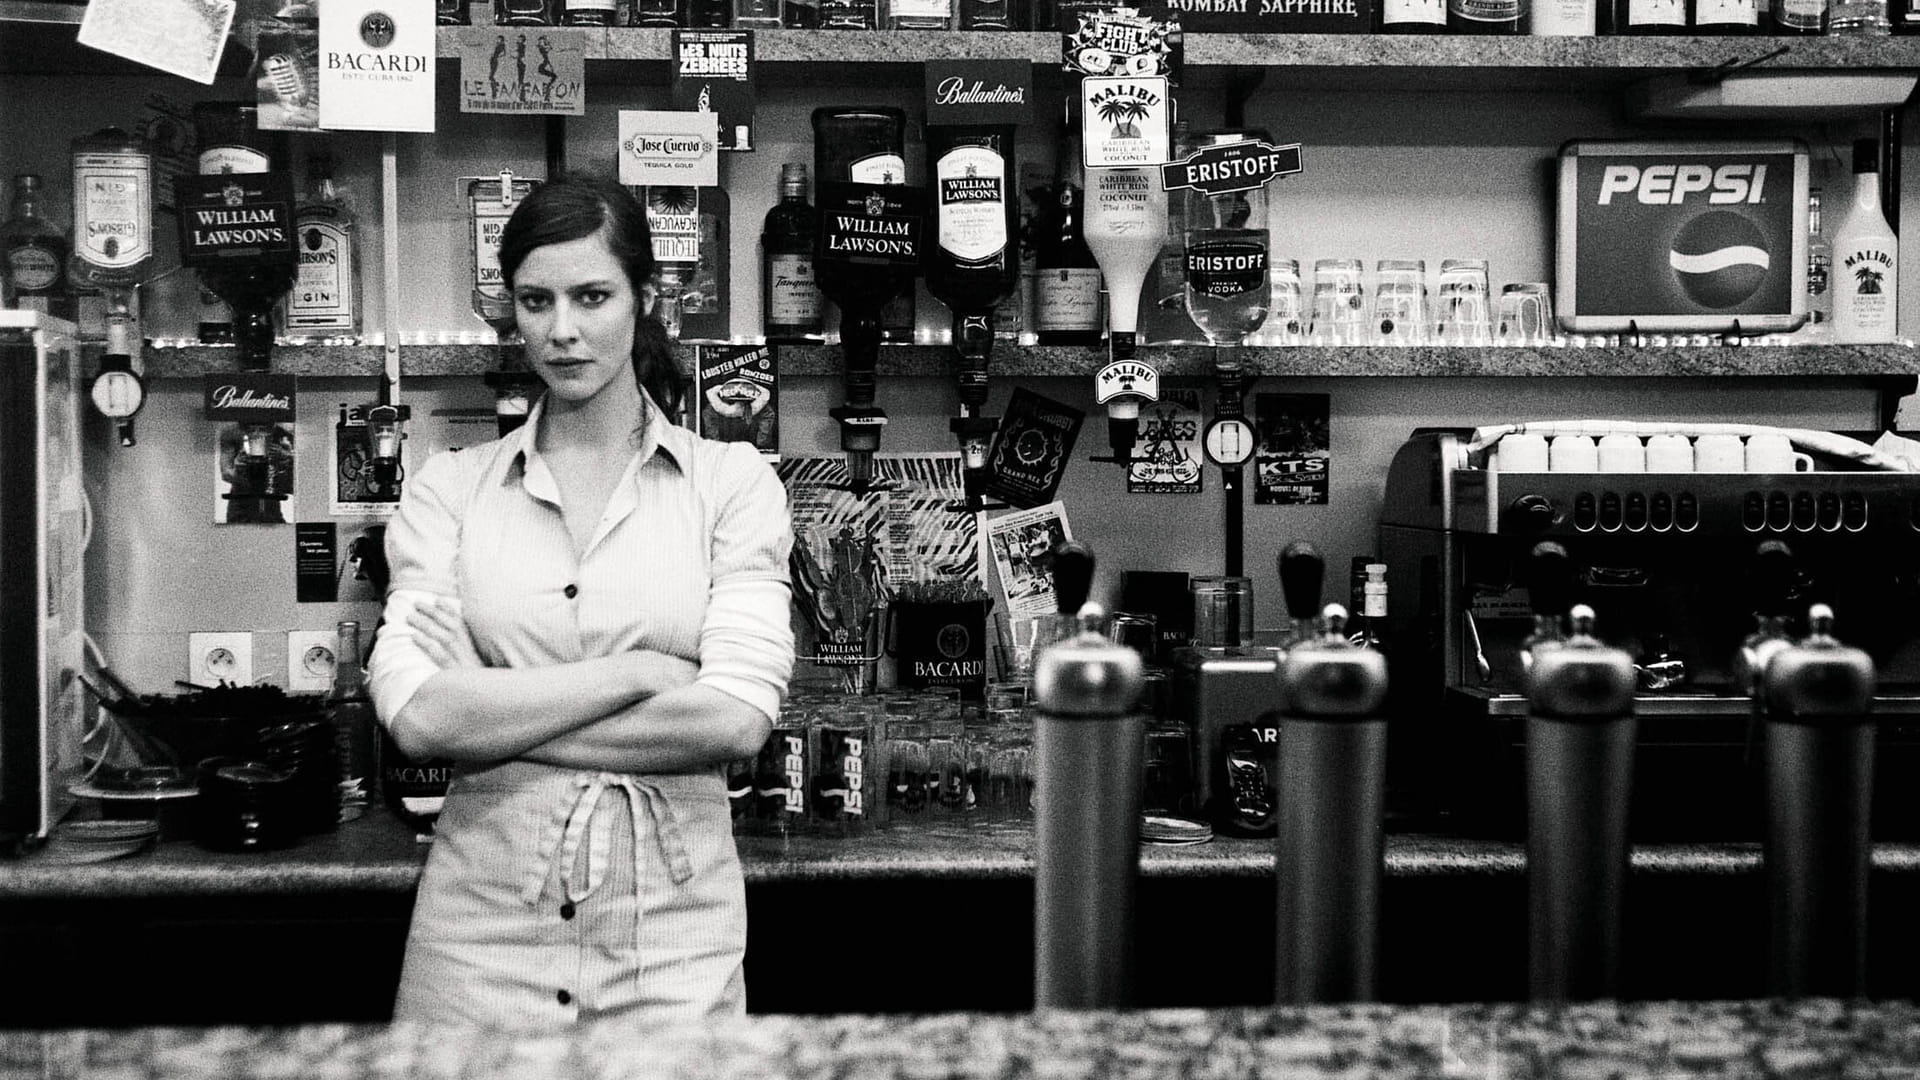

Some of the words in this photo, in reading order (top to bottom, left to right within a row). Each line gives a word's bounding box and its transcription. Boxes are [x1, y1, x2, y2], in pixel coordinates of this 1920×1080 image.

[1259, 0, 1358, 16] SAPPHIRE
[1095, 22, 1150, 44] FIGHT
[680, 43, 704, 57] LES
[709, 43, 748, 57] NUITS
[1101, 38, 1139, 55] CLUB
[328, 52, 426, 73] BACARDI
[680, 57, 748, 74] ZEBREES
[464, 81, 486, 96] LE
[489, 79, 580, 101] FANFARON
[935, 76, 1025, 105] Ballantine's
[1089, 85, 1160, 108] MALIBU
[636, 137, 662, 154] Jose
[663, 138, 700, 154] Cuervo
[1186, 154, 1280, 184] ERISTOFF
[948, 179, 996, 190] WILLIAM
[1598, 165, 1767, 205] PEPSI
[1099, 194, 1148, 202] COCONUT
[196, 208, 276, 225] WILLIAM
[836, 215, 910, 236] WILLIAM
[88, 221, 136, 238] GIBSON'S
[1189, 253, 1264, 271] ERISTOFF
[1844, 250, 1894, 270] MALIBU
[303, 293, 330, 302] GIN
[1208, 285, 1244, 293] VODKA
[701, 361, 735, 380] LOBSTER
[1102, 365, 1154, 385] MALIBU
[213, 385, 290, 410] Ballantine's
[1259, 459, 1325, 475] KTS
[820, 643, 862, 653] WILLIAM
[914, 660, 983, 677] BACARDI
[784, 735, 804, 814] PEPSI
[843, 737, 863, 816] PEPSI
